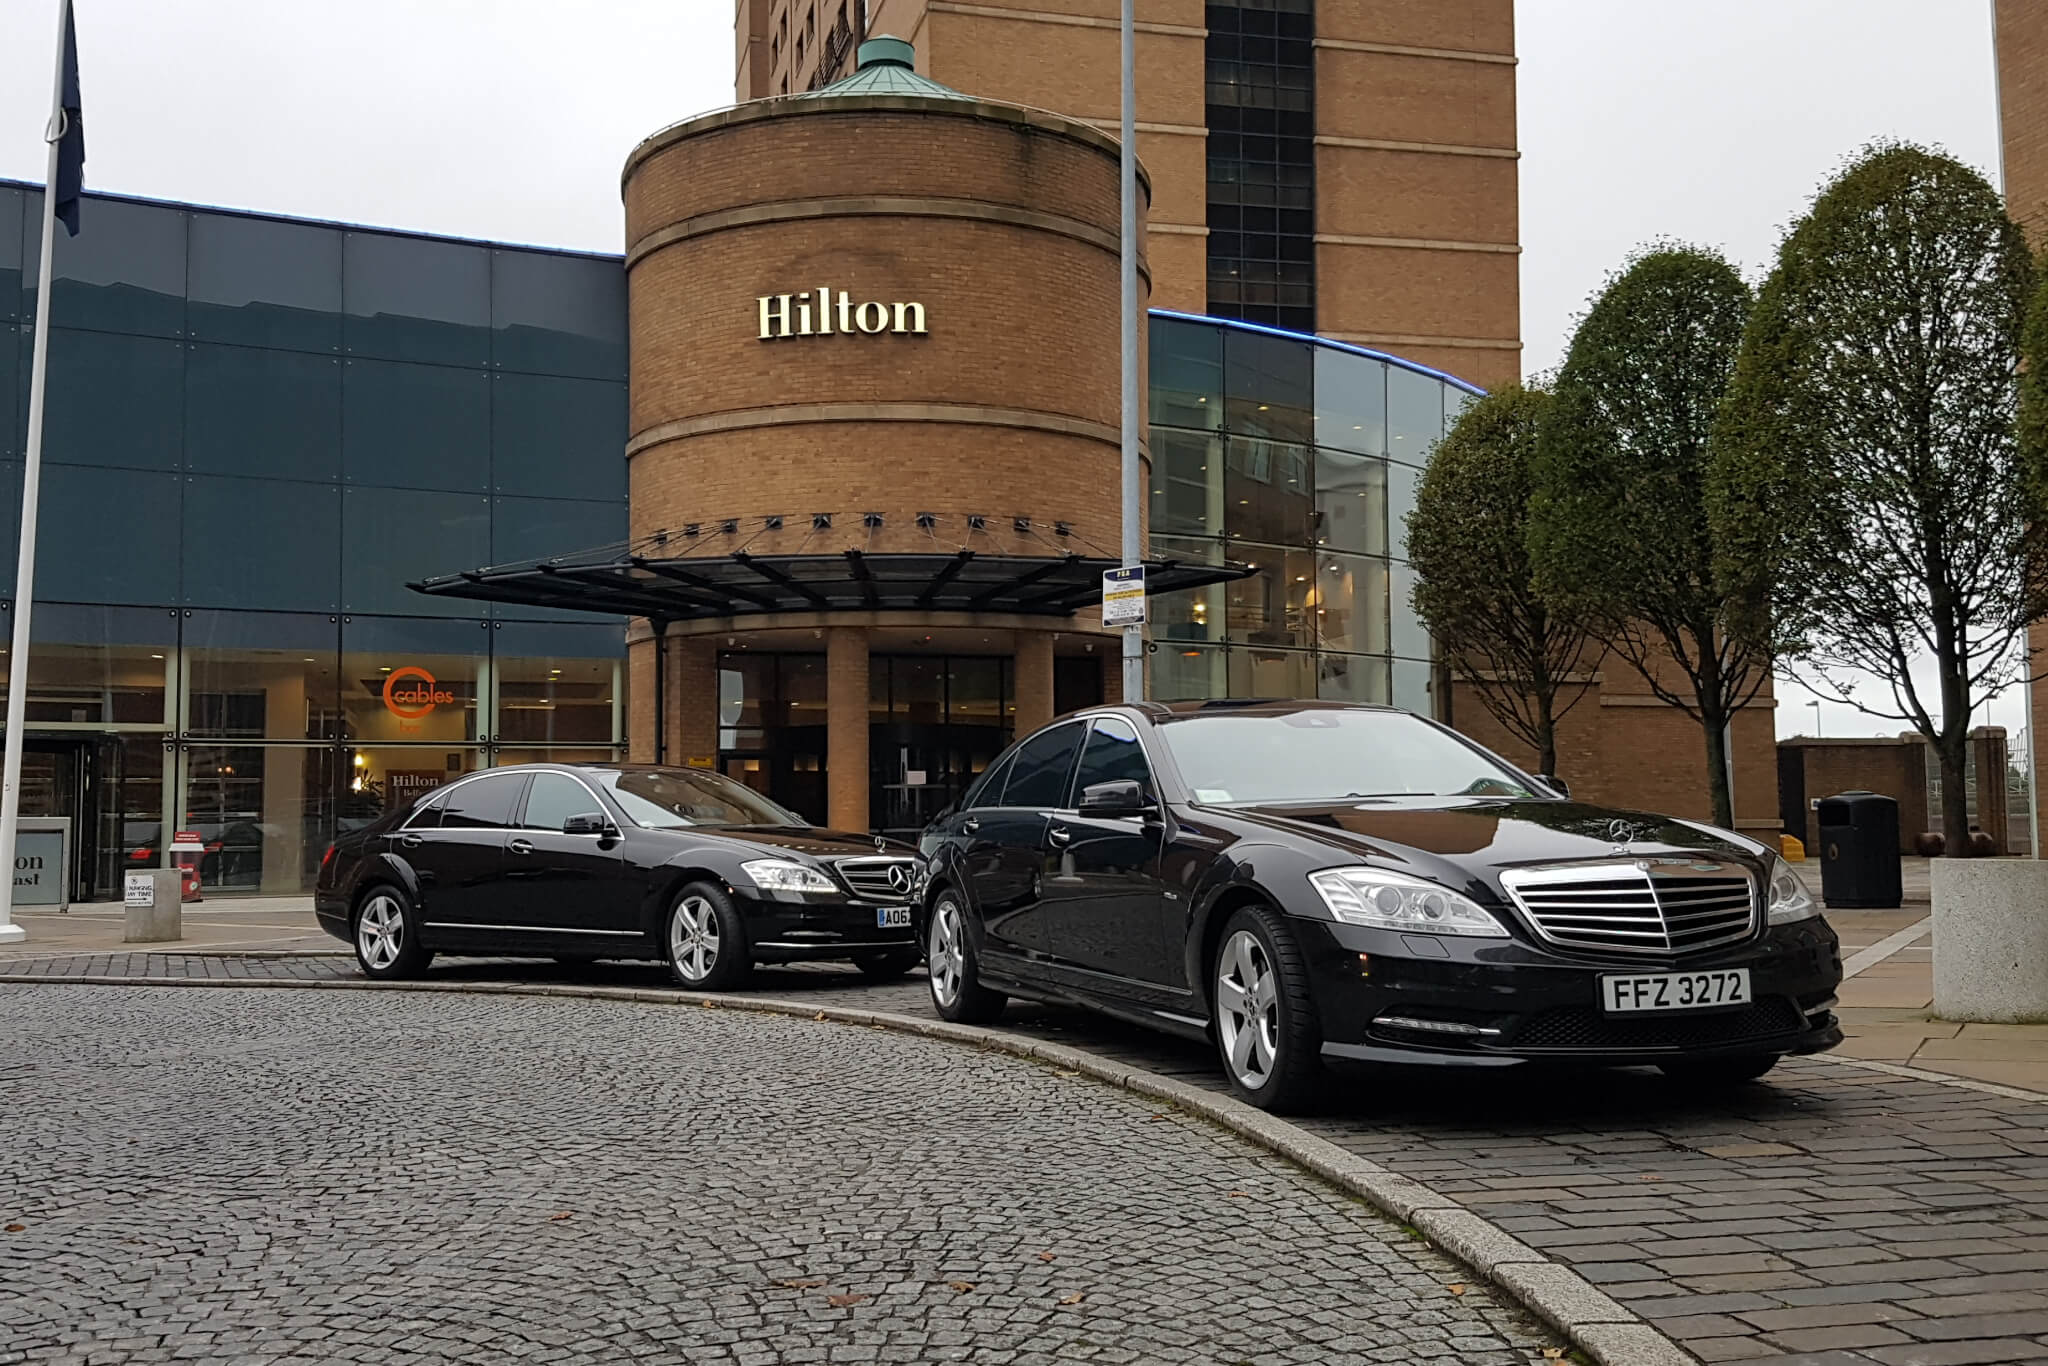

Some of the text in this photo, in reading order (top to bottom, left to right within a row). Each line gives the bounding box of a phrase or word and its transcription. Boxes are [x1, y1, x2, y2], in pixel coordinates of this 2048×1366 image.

[757, 287, 928, 339] Hilton
[393, 774, 439, 787] Hilton
[1614, 972, 1743, 1009] FFZ 3272
